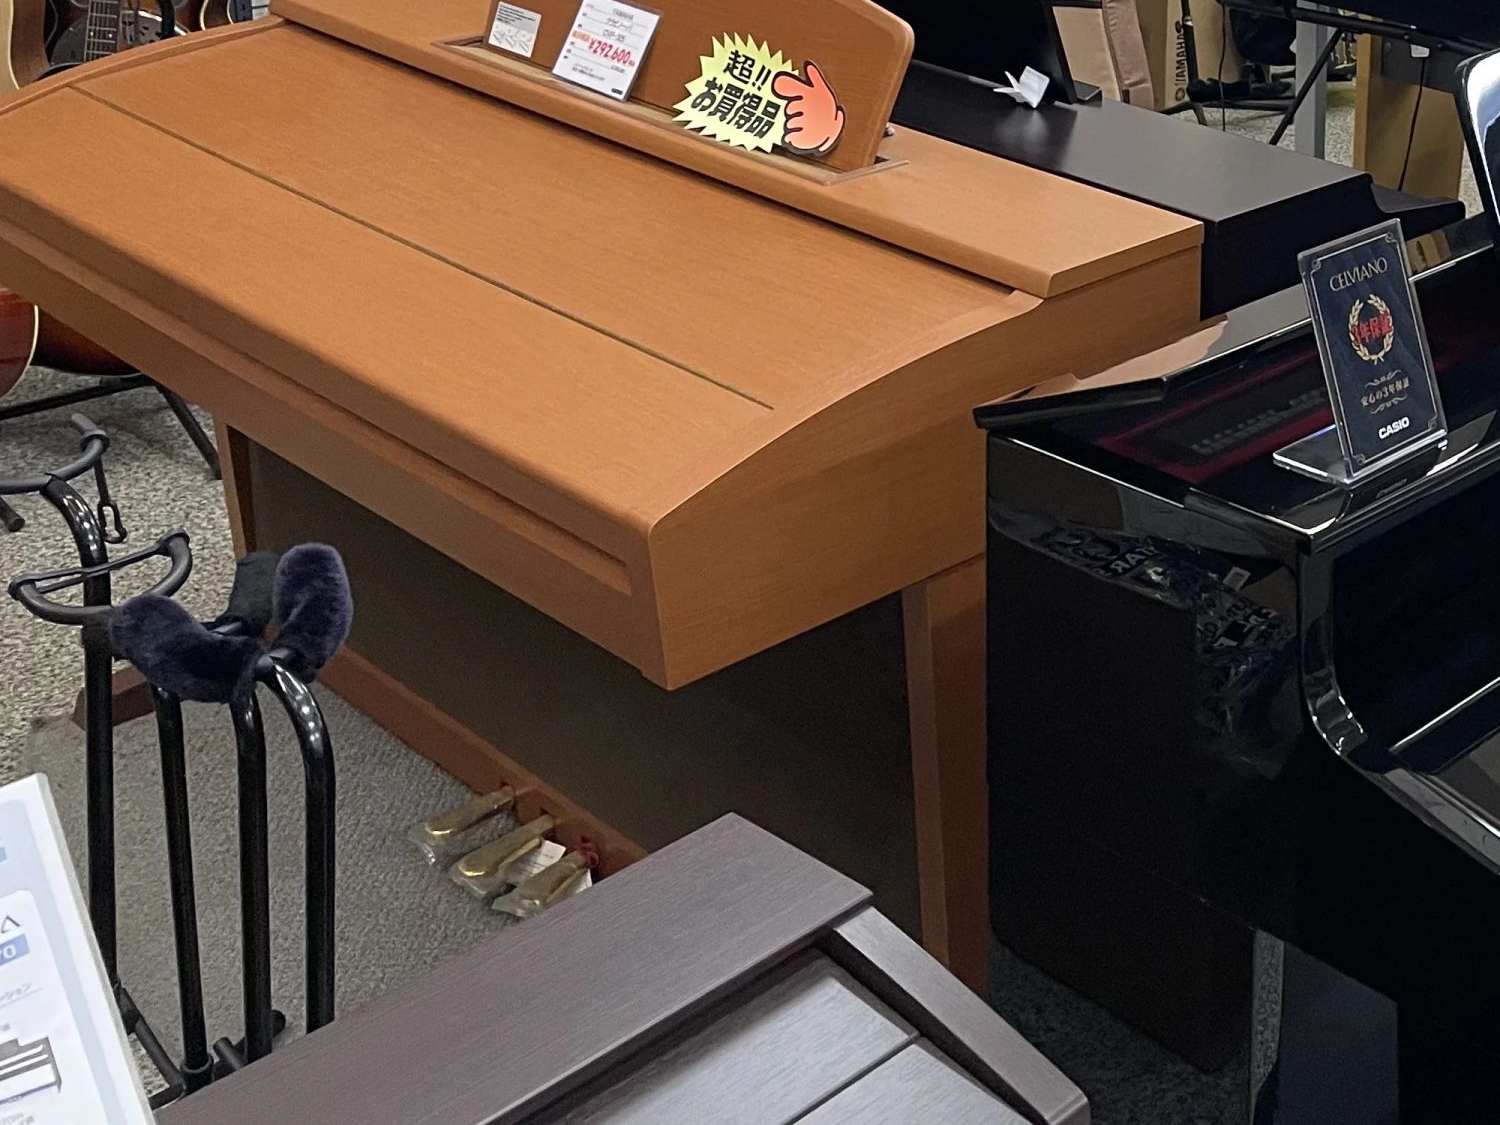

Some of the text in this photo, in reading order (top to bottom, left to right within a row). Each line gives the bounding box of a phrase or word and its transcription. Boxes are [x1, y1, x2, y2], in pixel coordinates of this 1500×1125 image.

[691, 77, 781, 139] お買得品
[1329, 257, 1388, 292] CELVIANO
[1378, 416, 1410, 440] CASIO
